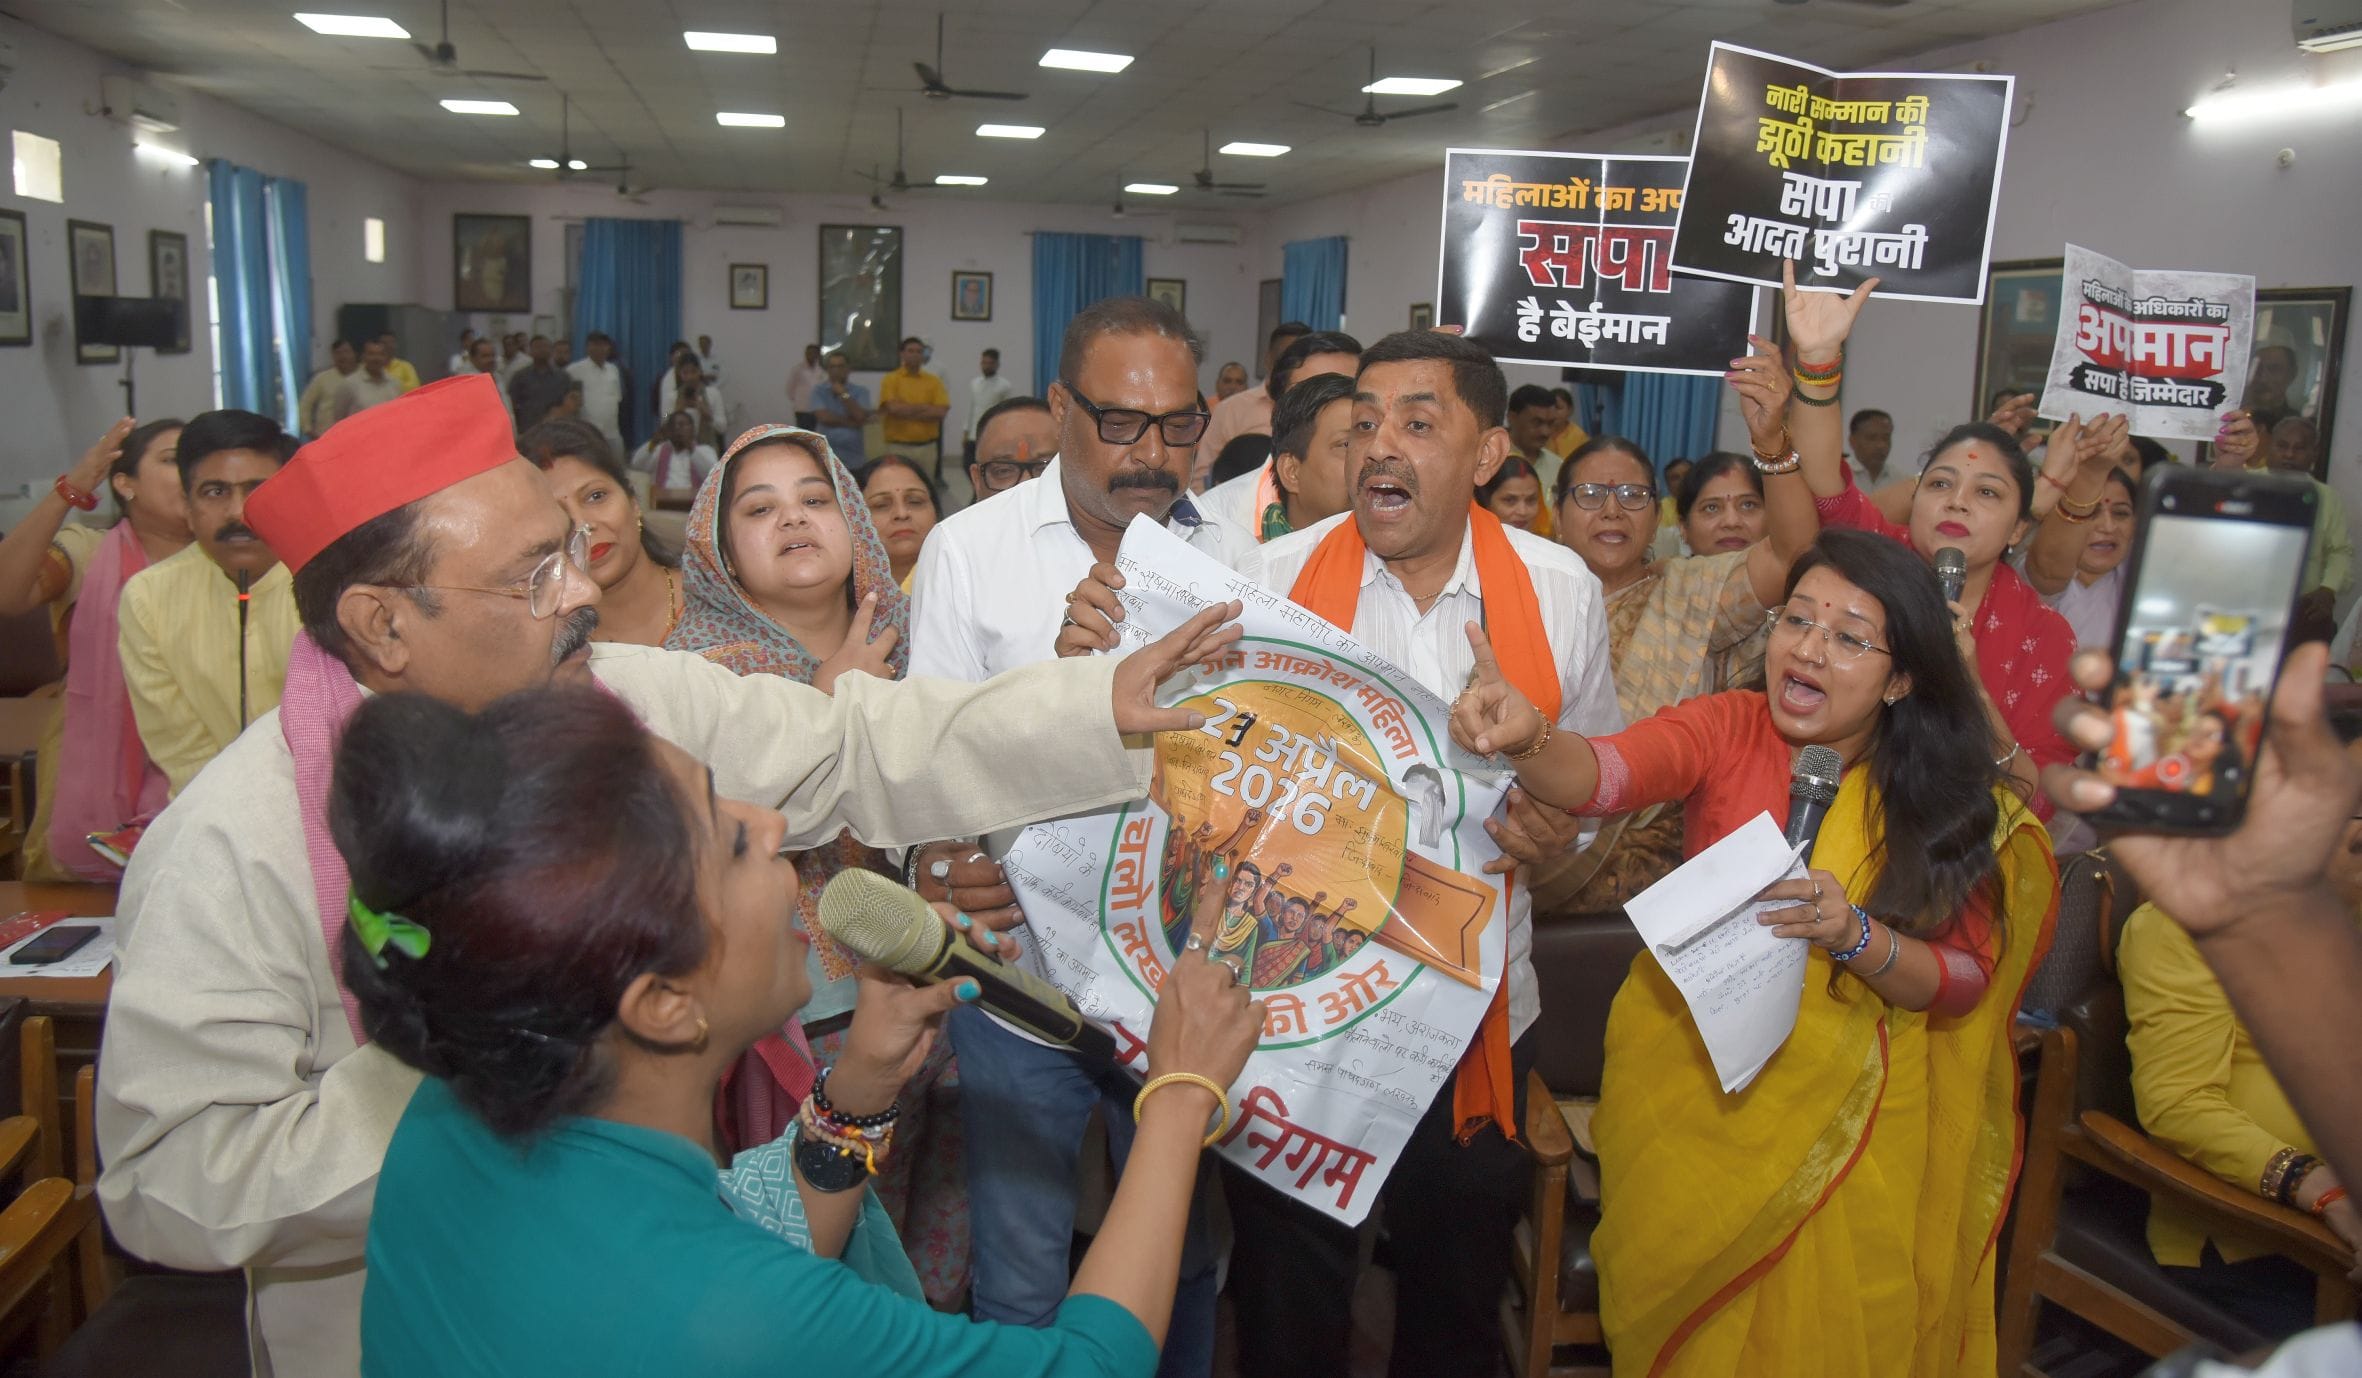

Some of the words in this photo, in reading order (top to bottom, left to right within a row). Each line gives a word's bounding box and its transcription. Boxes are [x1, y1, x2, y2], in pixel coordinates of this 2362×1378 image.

[1766, 84, 1808, 115] नारी
[1810, 95, 1892, 124] सम्मान
[1895, 95, 1929, 125] की
[1757, 116, 1814, 169] झूठी
[1816, 125, 1928, 169] कहानी
[1463, 173, 1590, 209] महिलाओं
[1594, 186, 1635, 212] का
[1780, 171, 1862, 222] सपा
[1517, 219, 1676, 293] सपा
[1724, 214, 1810, 261] आदत
[1813, 223, 1929, 277] पुरानी
[1517, 296, 1544, 343] है
[1550, 300, 1671, 348] बेईमान
[2082, 280, 2124, 309] महिलाओं
[2133, 297, 2204, 318] अधिकारों
[2205, 303, 2229, 319] का
[2077, 304, 2230, 371] अपमान
[2084, 369, 2118, 395] सपा
[2118, 371, 2129, 400] है
[2129, 376, 2212, 406] जिम्मेदार
[1225, 577, 1279, 610] महिला
[1336, 634, 1359, 655] का
[1254, 651, 1361, 691] आक्रोश
[1356, 685, 1420, 760] महिला
[1210, 751, 1332, 835] 2026
[1255, 723, 1379, 811] अप्रैल
[1111, 817, 1155, 910] चलो
[1318, 959, 1400, 1025] ओर
[1219, 1085, 1378, 1210] निगम
